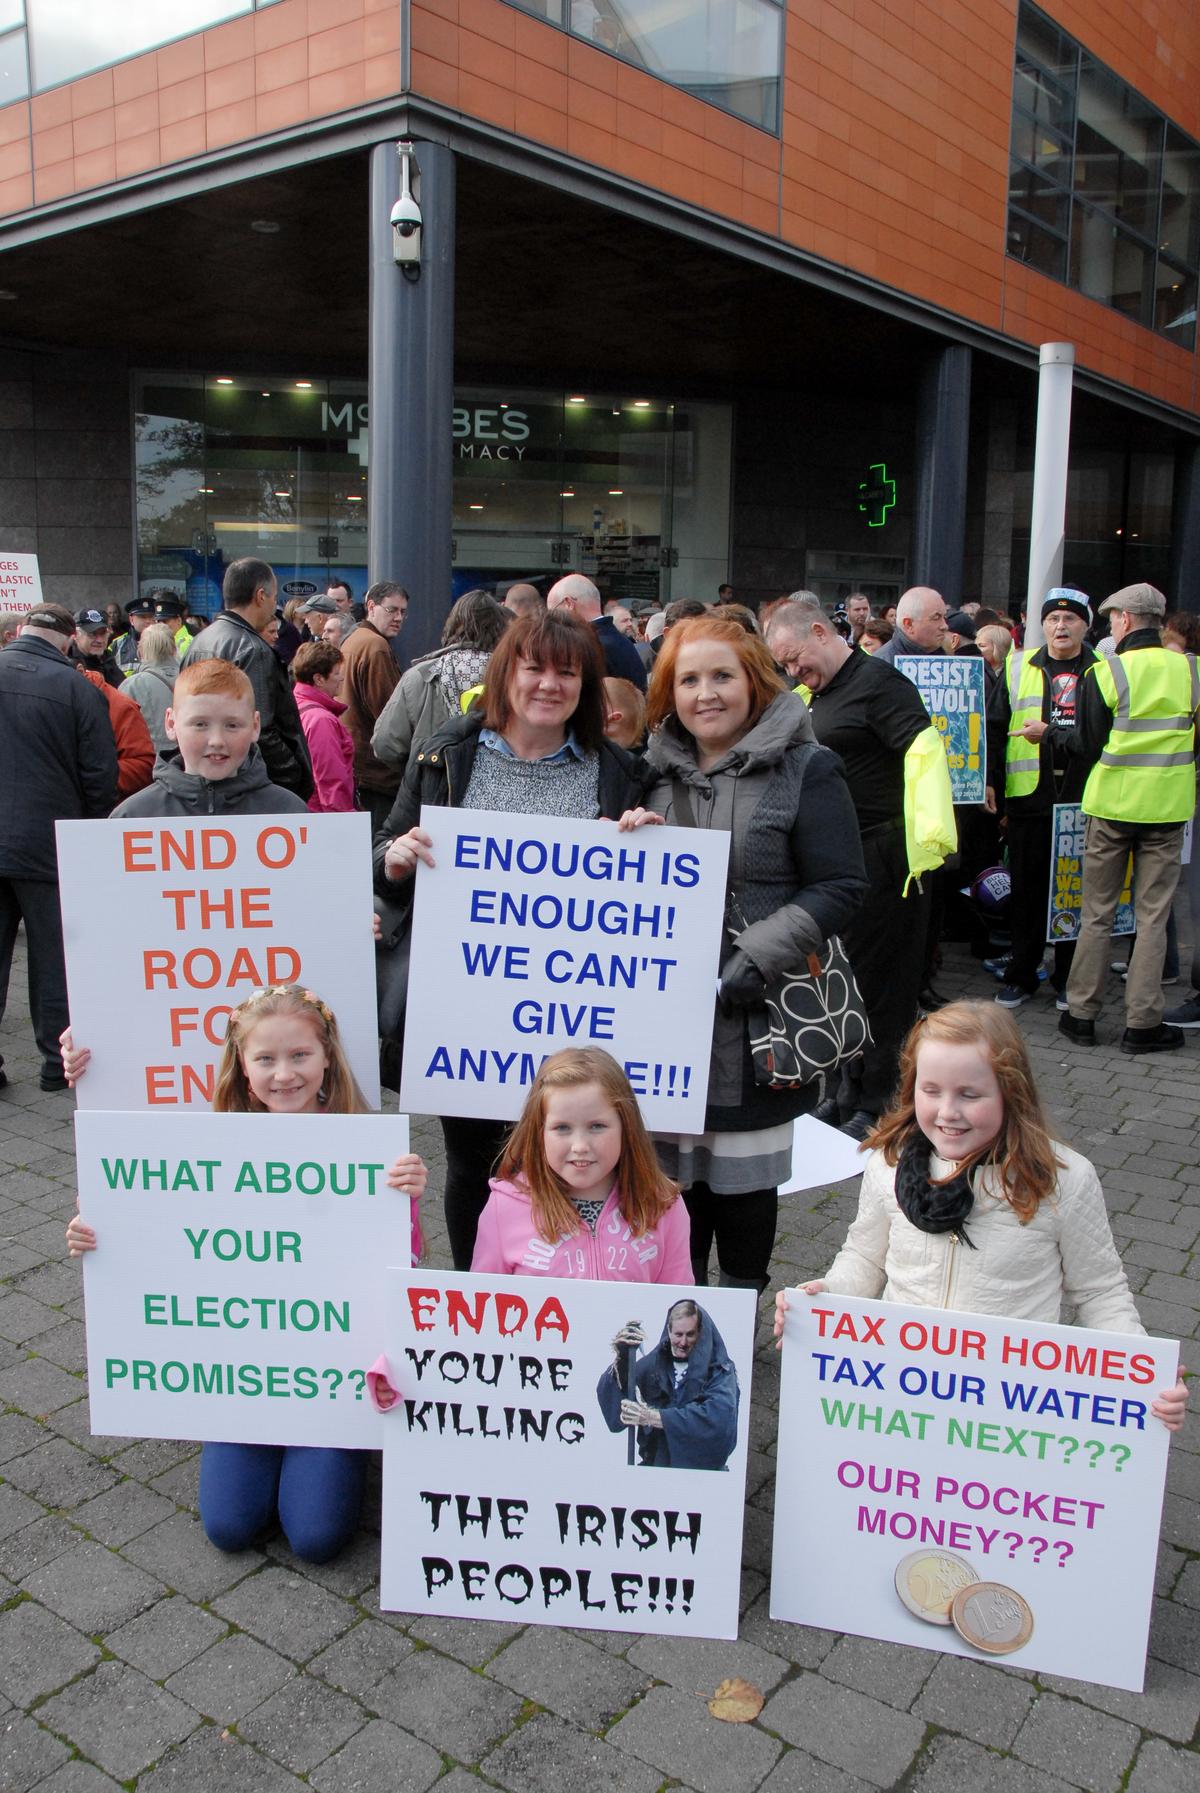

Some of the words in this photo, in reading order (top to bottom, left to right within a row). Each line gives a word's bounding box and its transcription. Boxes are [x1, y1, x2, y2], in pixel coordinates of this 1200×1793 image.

[460, 444, 527, 461] MACY
[902, 661, 973, 686] RESIST
[919, 688, 978, 713] EVOLT
[123, 829, 237, 872] END
[256, 826, 308, 869] O'
[455, 834, 646, 882] ENOUGH
[661, 852, 700, 888] IS
[1057, 856, 1080, 874] No
[162, 887, 273, 930] THE
[470, 889, 676, 939] ENOUGH!
[143, 946, 301, 990] ROAD
[461, 942, 530, 980] WE
[545, 949, 677, 991] CAN'T
[170, 1005, 232, 1047] FO
[512, 1000, 615, 1040] GIVE
[145, 1064, 214, 1105] EN
[425, 1046, 692, 1098] ANYME!!!
[101, 1158, 222, 1192] WHAT
[234, 1161, 385, 1196] ABOUT
[184, 1227, 302, 1263] YOUR
[143, 1294, 350, 1332] ELECTION
[407, 1287, 570, 1343] ENDA
[811, 1308, 885, 1345] TAX
[899, 1321, 987, 1360] OUR
[1001, 1336, 1156, 1385] HOMES
[404, 1348, 573, 1391] YOU'RE
[811, 1352, 885, 1390] TAX
[899, 1366, 986, 1405] OUR
[1001, 1381, 1148, 1430] WATER
[404, 1399, 585, 1444] KILLING
[820, 1398, 935, 1441] WHAT
[946, 1418, 1132, 1473] NEXT???
[837, 1460, 921, 1499] OUR
[935, 1476, 1105, 1529] POCKET
[420, 1491, 529, 1540] THE
[555, 1502, 702, 1555] IRISH
[857, 1505, 1075, 1568] MONEY???
[421, 1556, 695, 1616] PEOPLE!!!
